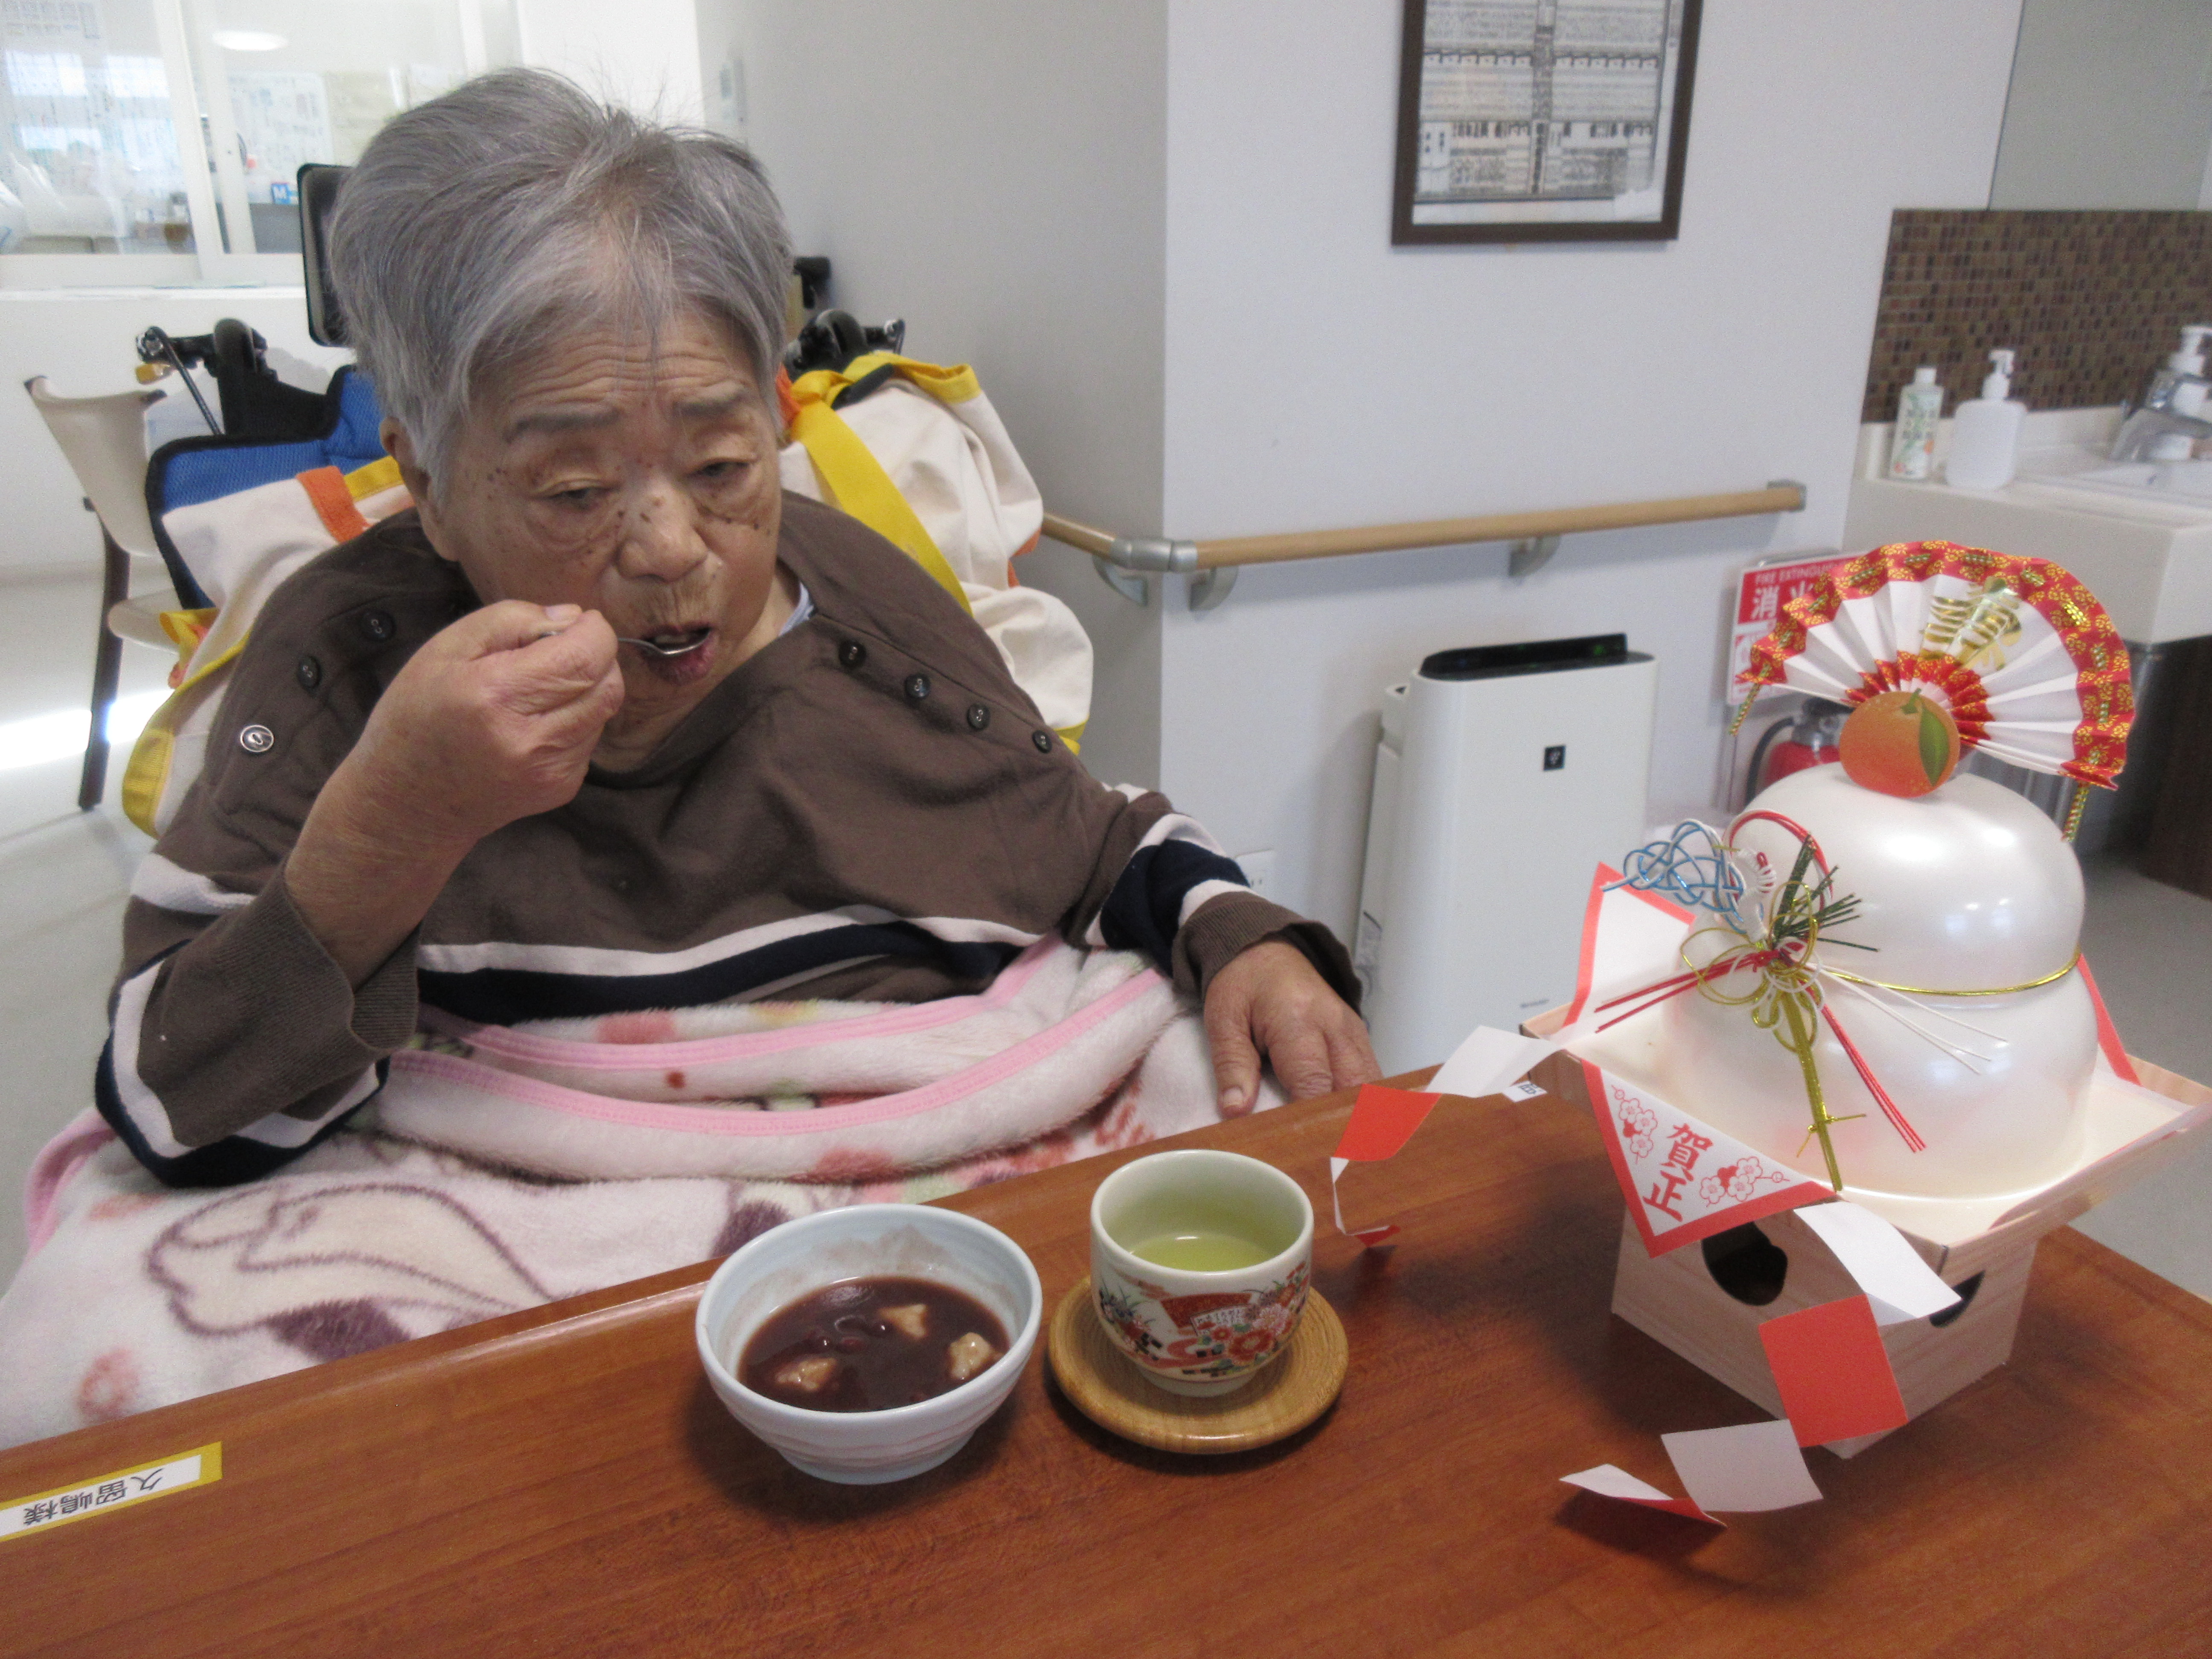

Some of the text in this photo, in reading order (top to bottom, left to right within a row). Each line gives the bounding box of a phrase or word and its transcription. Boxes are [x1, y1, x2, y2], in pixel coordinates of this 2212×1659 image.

[1643, 1123, 1714, 1222] 賀正
[23, 1468, 164, 1525] 久留嶋様
